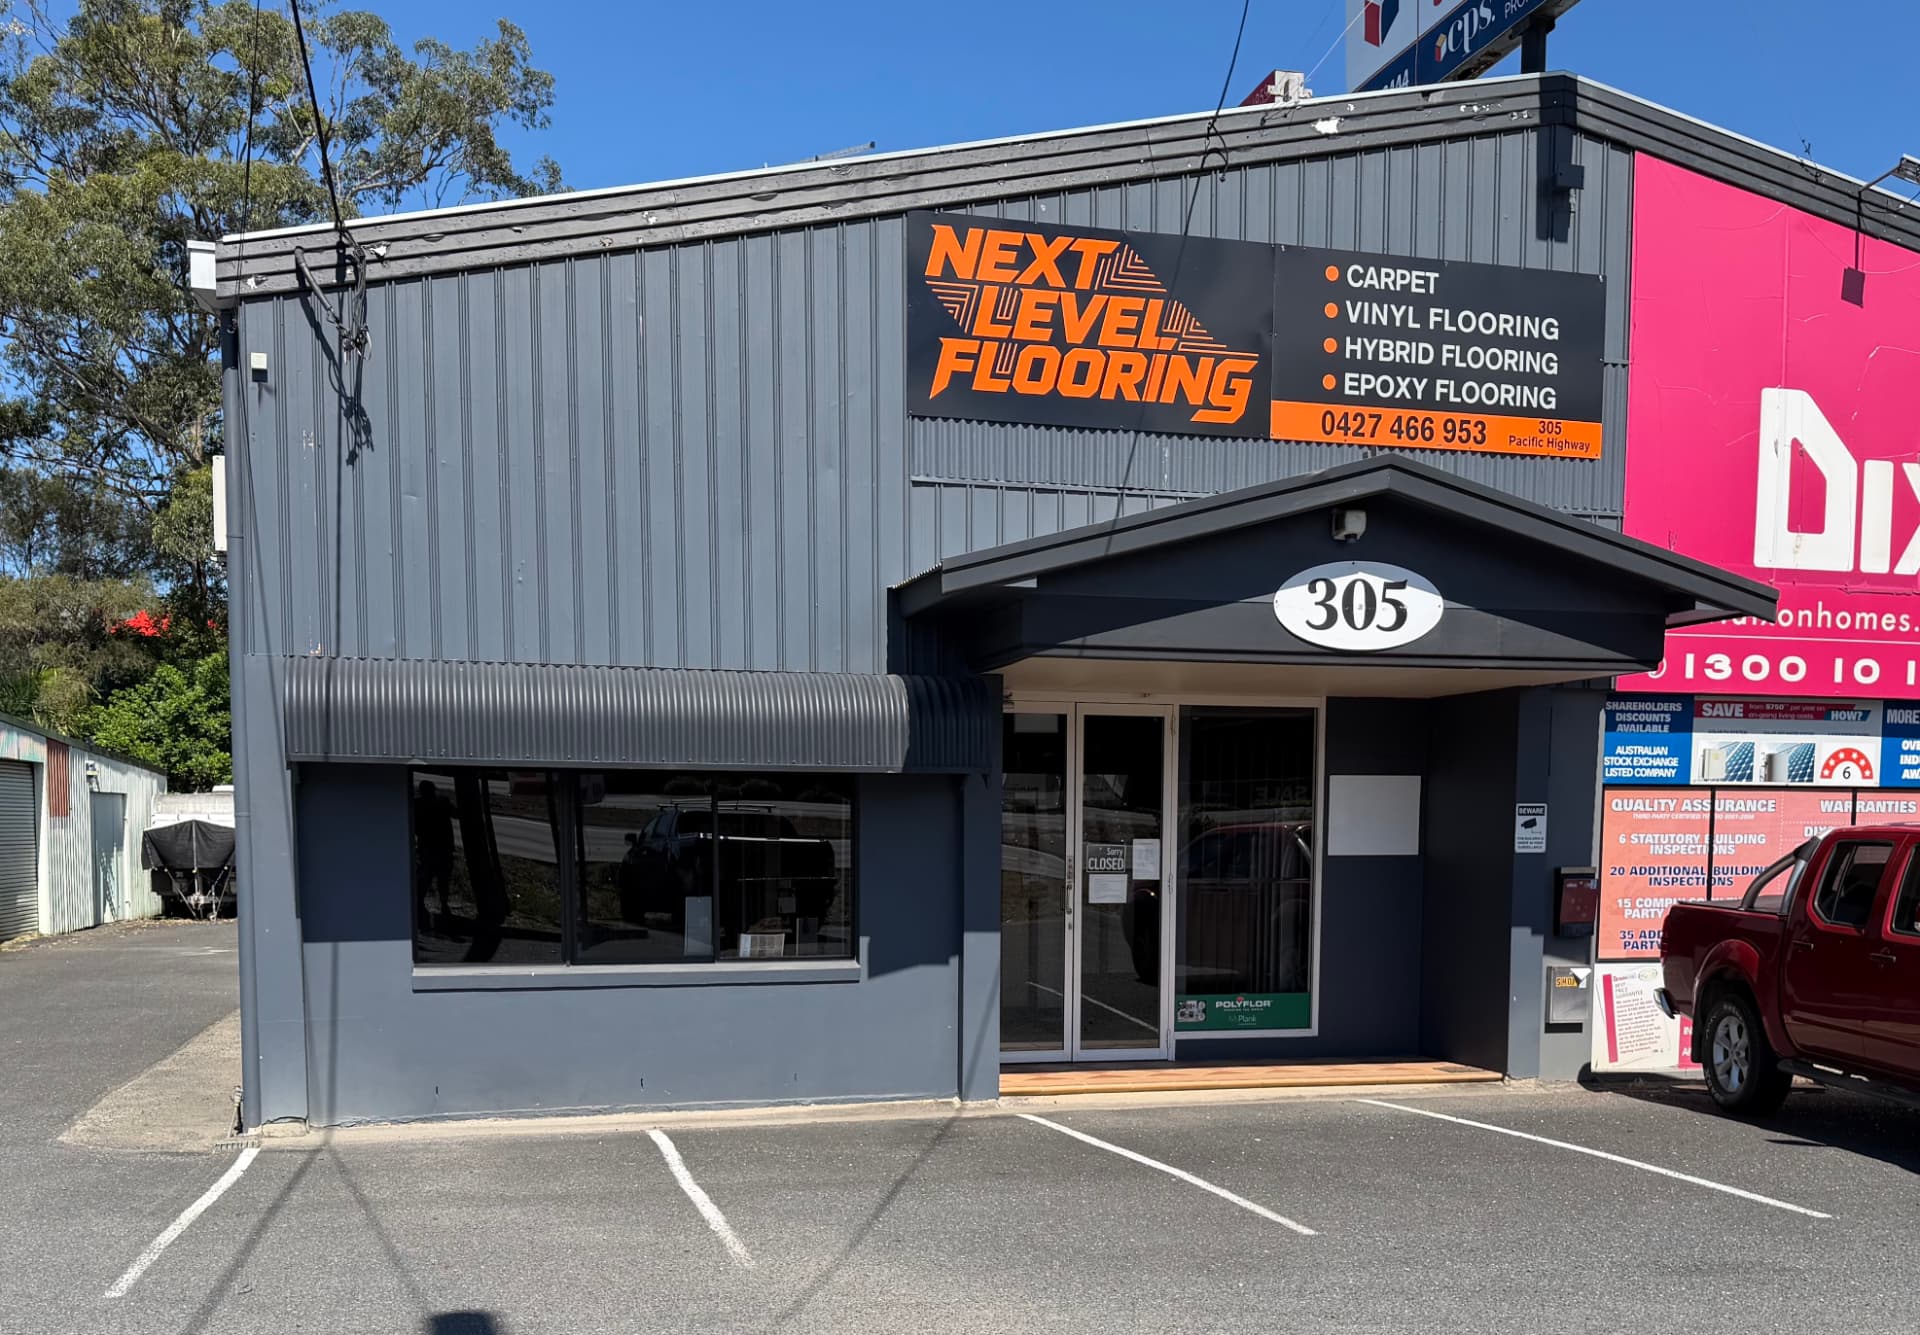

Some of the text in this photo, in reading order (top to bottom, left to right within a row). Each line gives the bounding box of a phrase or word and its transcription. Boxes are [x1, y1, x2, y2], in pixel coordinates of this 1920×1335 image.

[924, 224, 1120, 290] NEXT
[1347, 264, 1439, 294] CARPET
[972, 285, 1178, 350] LEVEL
[1346, 301, 1559, 340] VINYL FLOORING
[1345, 337, 1558, 375] HYBRID FLOORING
[930, 338, 1258, 424] FLOORING
[1344, 373, 1557, 409] EPOXY FLOORING
[1322, 410, 1487, 444] 0427 466 953
[1538, 421, 1562, 435] 305
[1509, 435, 1590, 453] Pacific Highway
[1306, 578, 1408, 632] 305
[1684, 653, 1807, 681] 1300
[1833, 658, 1880, 684] 10
[1605, 701, 1682, 712] SHAREHOLDERS
[1702, 703, 1744, 718] SAVE
[1615, 713, 1671, 722] DISCOUNTS
[1830, 710, 1863, 720] HOW?
[1886, 709, 1920, 724] MORE
[1616, 724, 1670, 733] AVAILABLE
[1615, 746, 1668, 755] AUSTRALIAN
[1604, 756, 1679, 767] STOCK EXCHANGE
[1605, 767, 1677, 778] LISTED COMPANY
[1842, 766, 1851, 779] 6
[1518, 807, 1544, 815] BEWARE
[1612, 799, 1776, 812] QUALITY ASSURANCE
[1618, 833, 1627, 844] 6
[1630, 833, 1703, 844] STATUTORY
[1106, 847, 1124, 858] Sorry
[1088, 857, 1124, 870] CLOSED
[1610, 866, 1769, 876] 20 ADDITIONAL BUILDIN
[1617, 898, 1630, 908] 15
[1624, 908, 1664, 919] PARTY
[1619, 930, 1634, 940] 35
[1215, 999, 1271, 1008] POLYFLOR
